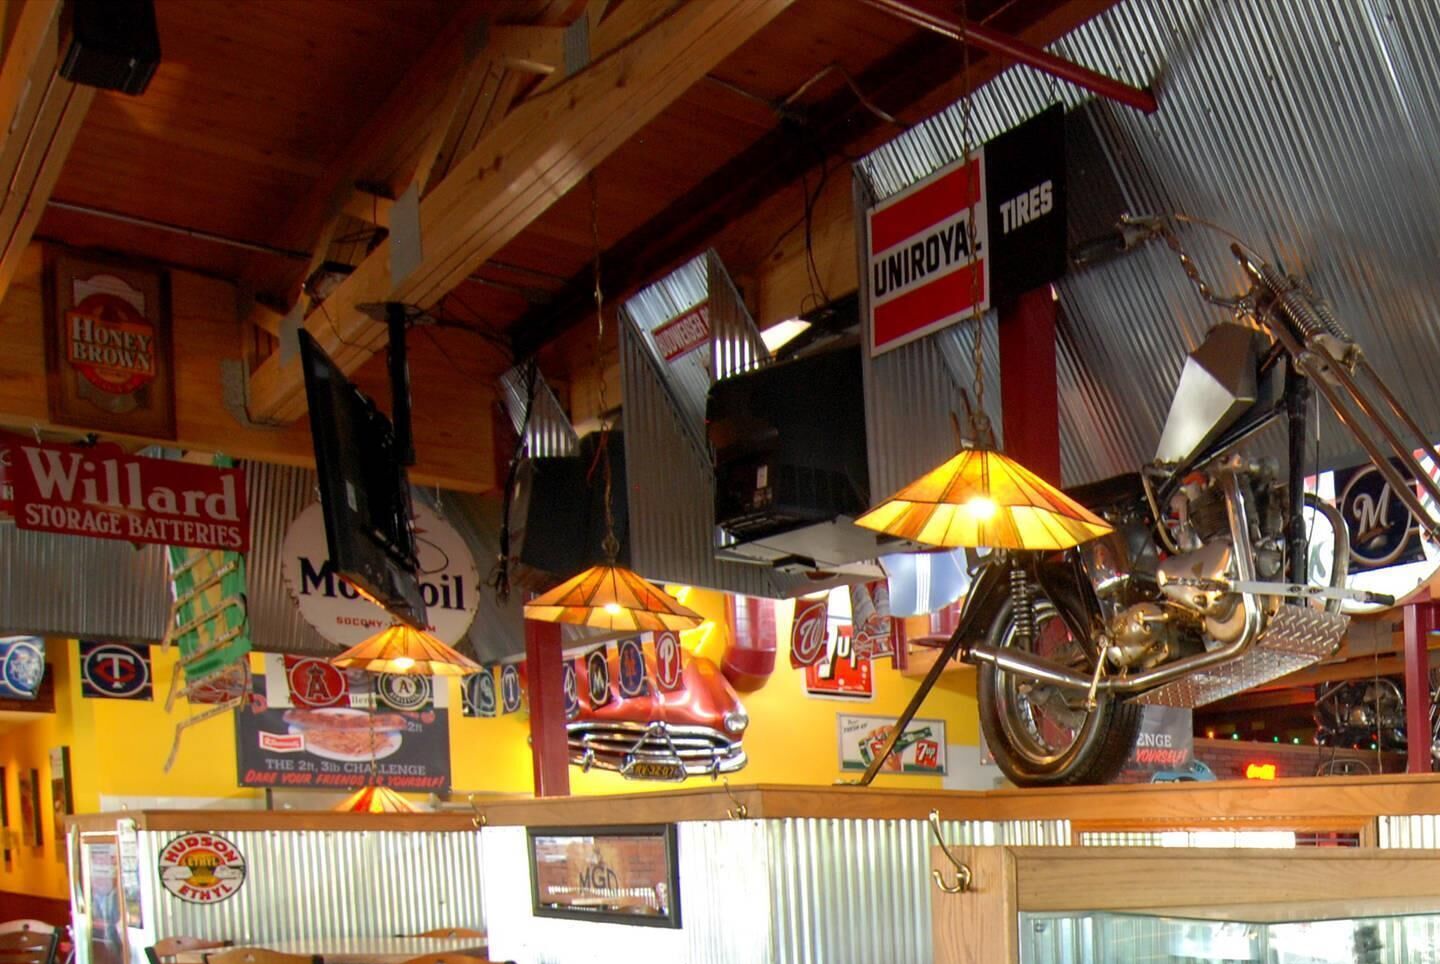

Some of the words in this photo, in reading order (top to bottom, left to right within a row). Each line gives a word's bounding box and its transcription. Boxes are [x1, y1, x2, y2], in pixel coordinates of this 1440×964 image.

[999, 179, 1054, 235] TIRES
[873, 218, 983, 298] UNIROYA
[72, 316, 151, 349] HONEY
[72, 341, 150, 371] BROWN
[20, 445, 240, 522] Willard
[24, 502, 122, 535] STORAGE
[128, 514, 243, 548] BATTERIES
[297, 556, 466, 611] Mooil
[265, 758, 295, 771] THE
[343, 761, 426, 776] CHALENGE
[281, 771, 313, 785] YOUR
[316, 772, 365, 786] FRIENDS
[163, 835, 238, 865] HUDSON
[177, 884, 233, 901] ETHYL
